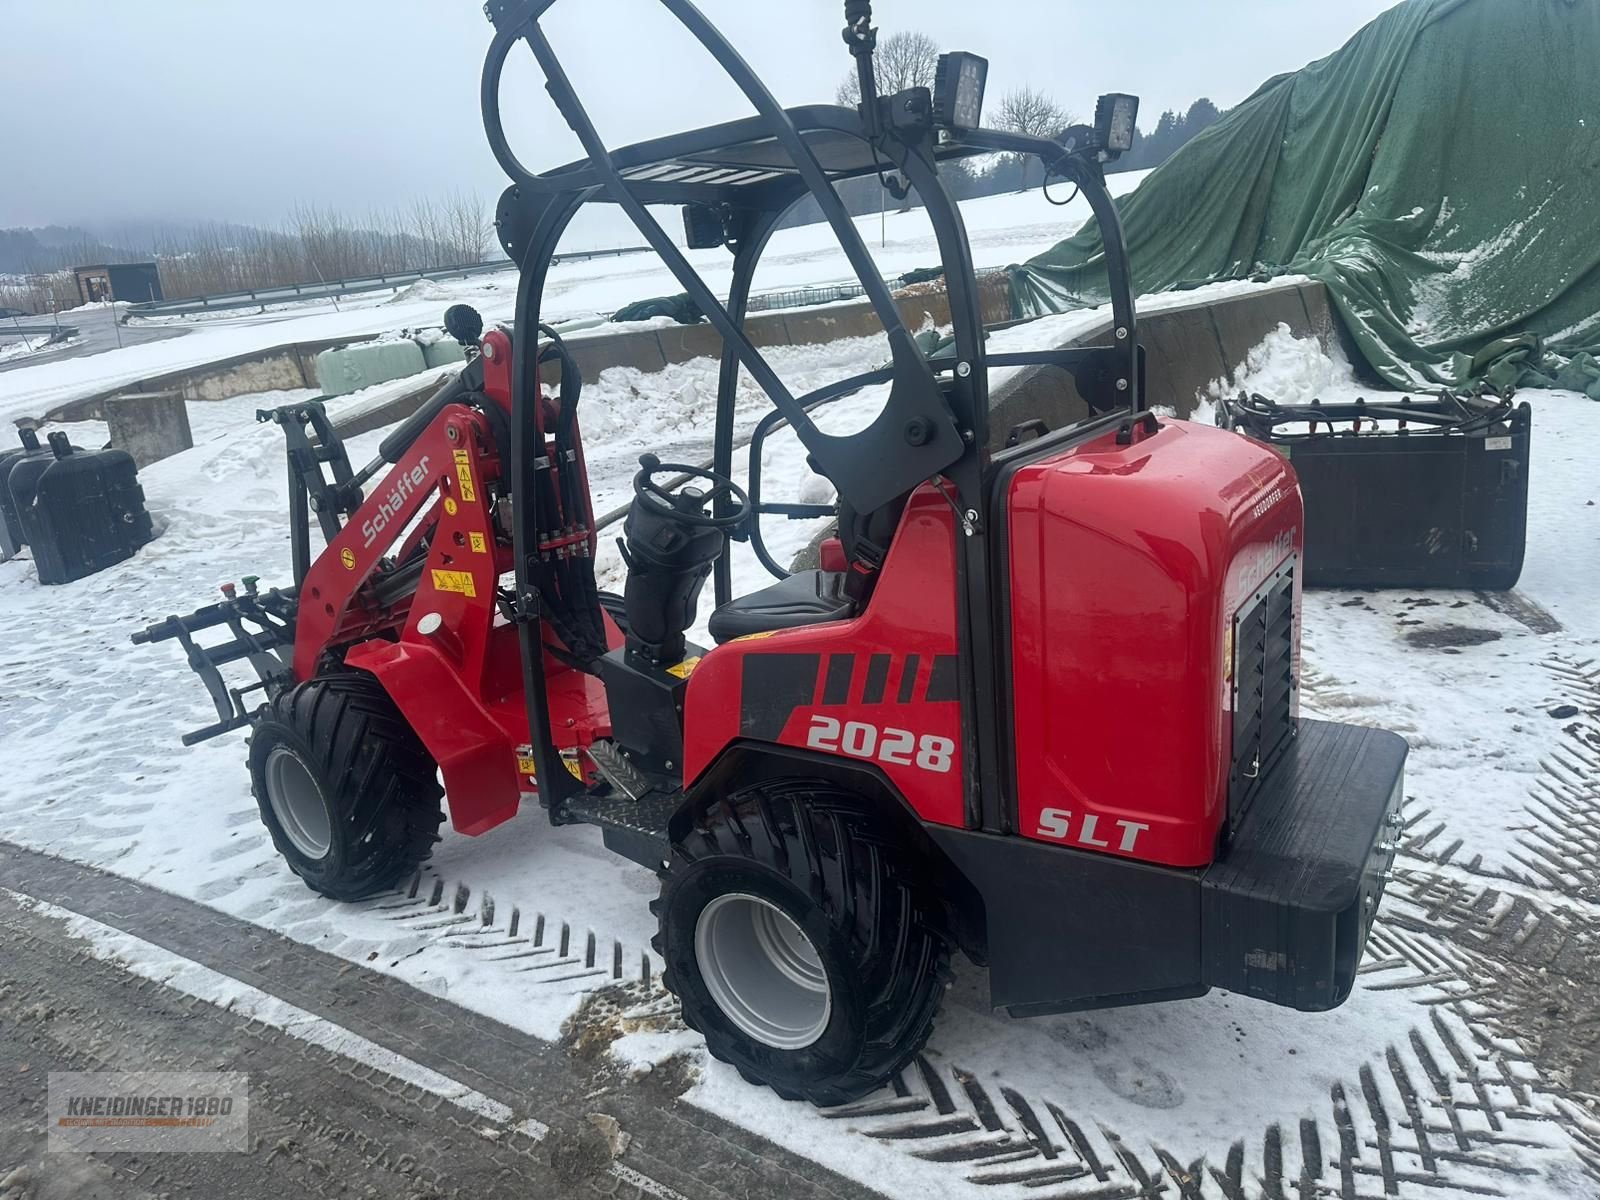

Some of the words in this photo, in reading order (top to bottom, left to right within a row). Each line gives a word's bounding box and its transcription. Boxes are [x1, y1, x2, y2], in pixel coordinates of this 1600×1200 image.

[362, 456, 430, 549] Schäffer
[1239, 526, 1296, 599] Schäffer
[807, 714, 954, 773] 2028
[1037, 807, 1149, 852] SLT
